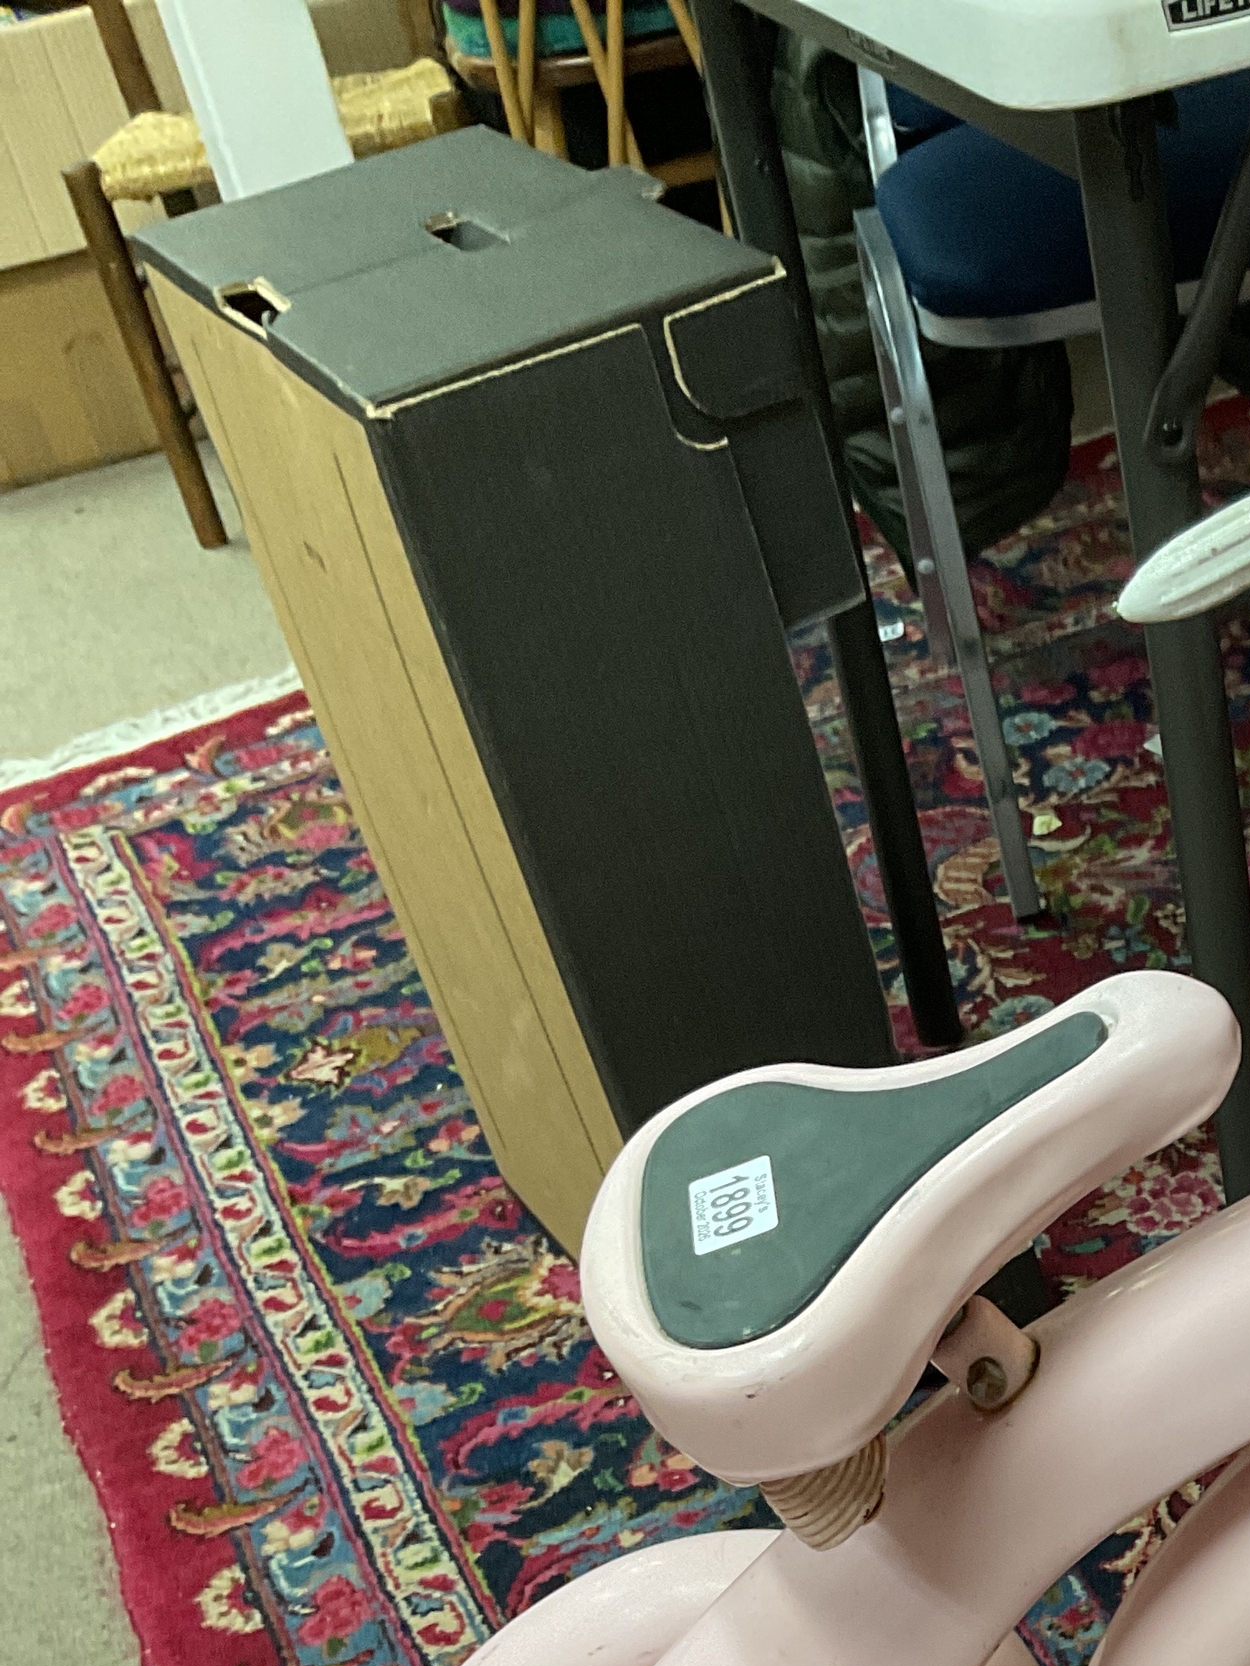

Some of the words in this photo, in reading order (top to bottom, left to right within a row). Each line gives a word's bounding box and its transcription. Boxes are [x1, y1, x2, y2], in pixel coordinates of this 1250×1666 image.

[694, 1190, 709, 1221] October
[709, 1175, 754, 1237] 1899
[754, 1173, 770, 1213] Stacey's
